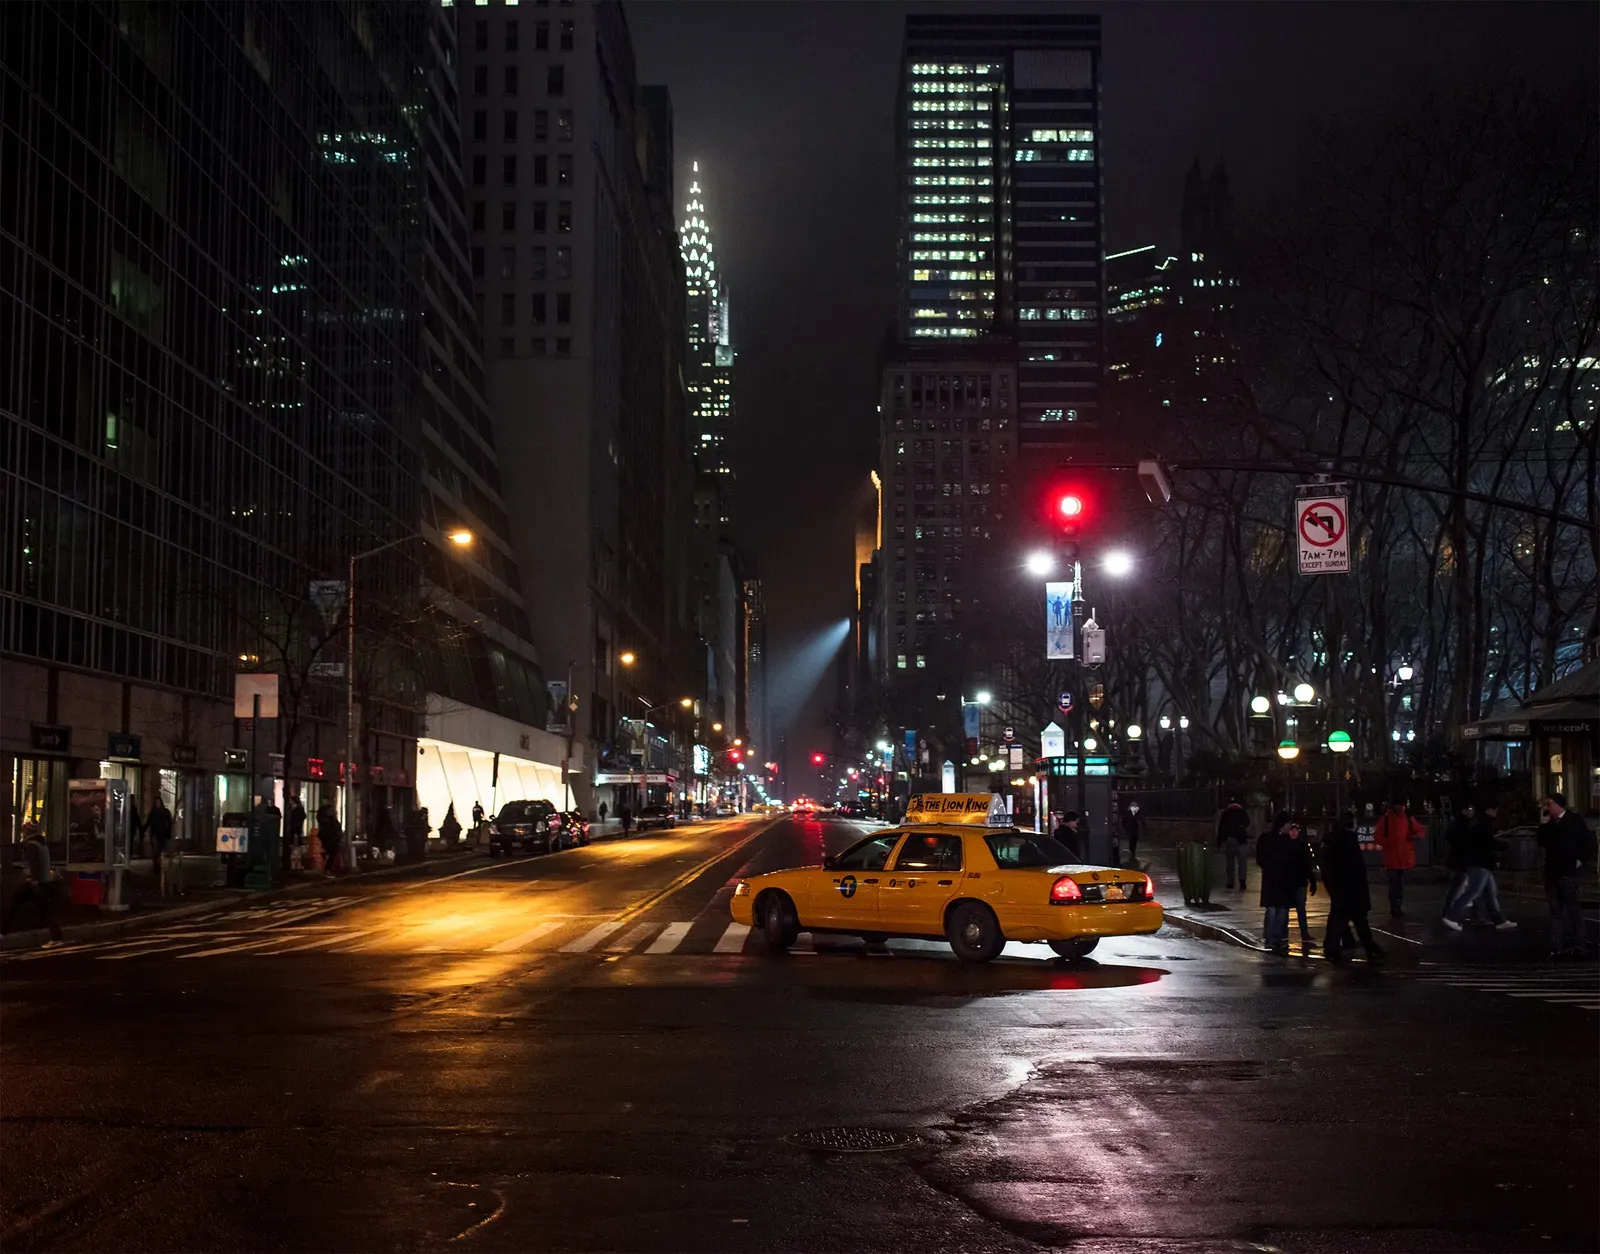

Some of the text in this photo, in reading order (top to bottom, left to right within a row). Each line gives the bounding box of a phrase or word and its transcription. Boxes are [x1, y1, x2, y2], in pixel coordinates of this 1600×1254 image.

[1302, 549, 1346, 561] 7AM-7PM
[1302, 561, 1322, 569] EXCEPT
[925, 798, 988, 813] THE LION KING
